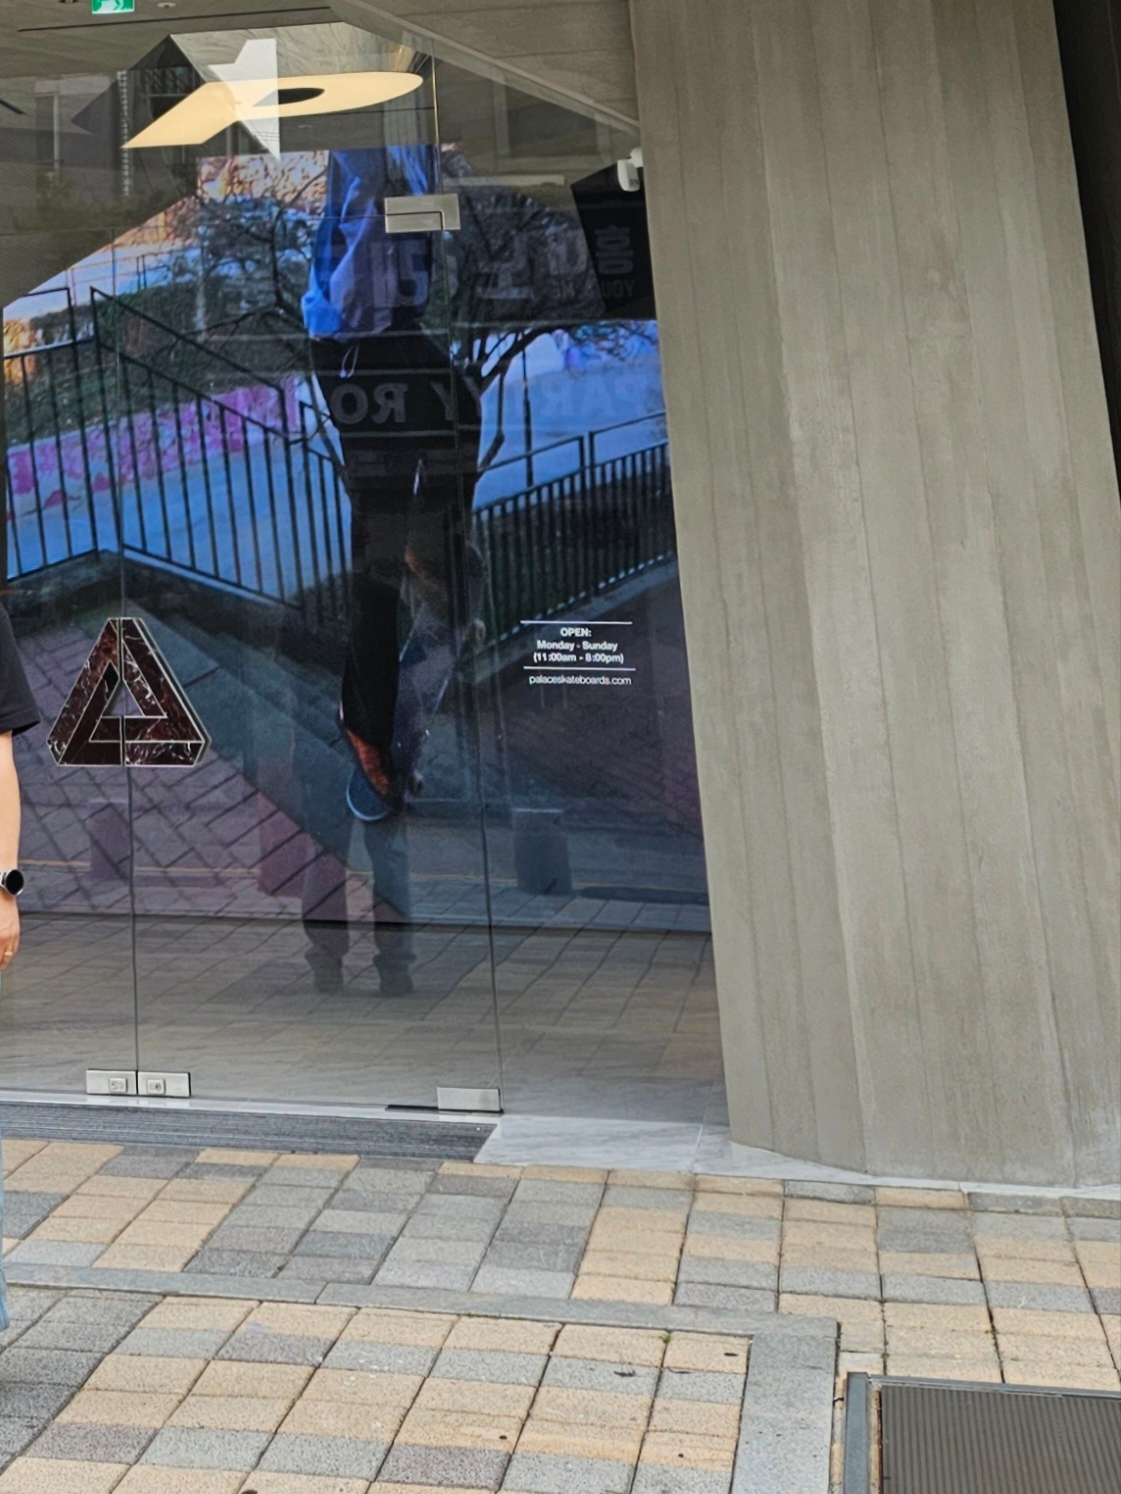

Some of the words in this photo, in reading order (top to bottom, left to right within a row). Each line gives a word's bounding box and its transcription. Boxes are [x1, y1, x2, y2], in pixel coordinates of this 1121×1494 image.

[560, 627, 592, 637] OPEN:
[536, 640, 575, 651] Monday
[582, 641, 618, 652] Sunday
[529, 675, 632, 685] palaceskateboards.com
